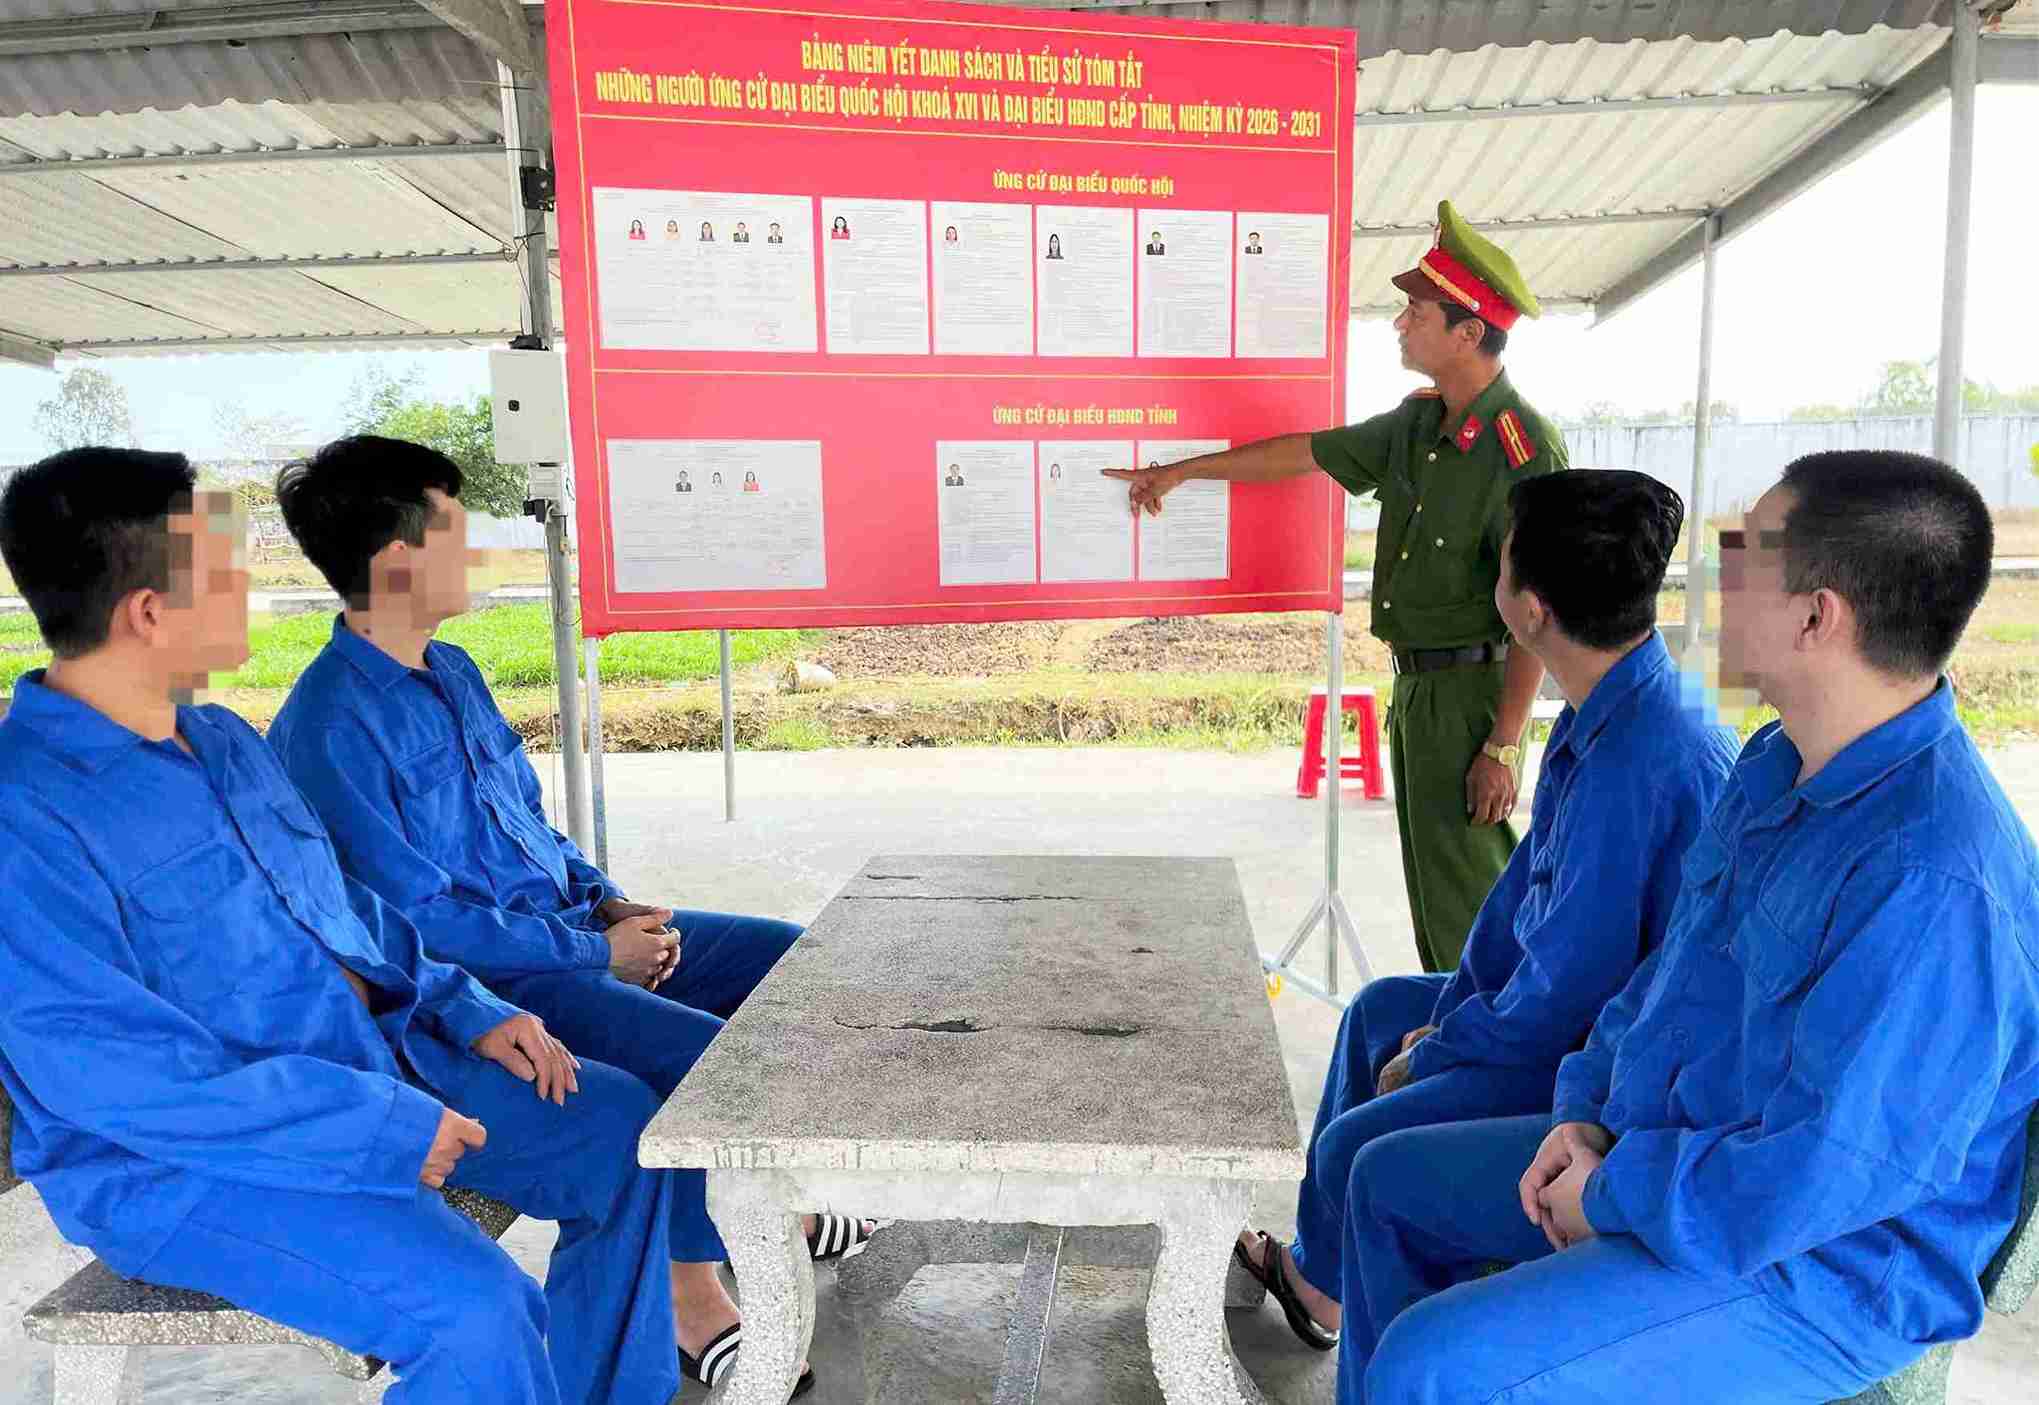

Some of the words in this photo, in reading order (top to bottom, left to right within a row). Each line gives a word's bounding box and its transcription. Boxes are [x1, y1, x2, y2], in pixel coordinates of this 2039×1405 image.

[801, 32, 844, 72] BẢNG
[847, 39, 886, 75] NIÊM
[890, 37, 916, 76] YẾT
[920, 48, 960, 77] DANH
[964, 44, 1002, 81] SÁCH
[1005, 48, 1024, 81] VÀ
[1028, 44, 1059, 83] TIỂU
[1063, 47, 1083, 85] SỬ
[1085, 53, 1115, 87] TÓM
[1119, 50, 1143, 88] TẮT
[595, 67, 652, 103] NHỮNG
[656, 69, 706, 106] NGƯỜI
[709, 72, 742, 109] ỨNG
[746, 71, 769, 110] CỬ
[770, 81, 797, 117] ĐẠI
[800, 74, 835, 113] BIỂU
[839, 78, 879, 117] QUỐC
[884, 83, 908, 123] HỘI
[912, 85, 952, 119] KHOÁ
[955, 91, 978, 121] XVI
[982, 89, 1000, 122] VÀ
[1004, 95, 1027, 128] ĐẠI
[1031, 86, 1063, 125] BIỂU
[1068, 98, 1105, 127] HĐND
[1109, 92, 1136, 128] CẤP
[1139, 93, 1175, 134] TỈNH,
[1179, 99, 1222, 138] NHIỆM
[1226, 101, 1244, 133] KỲ
[1247, 107, 1279, 135] 2026
[1291, 111, 1321, 137] 2031
[993, 169, 1024, 190] ỨNG
[1049, 174, 1073, 194] ĐẠI
[1076, 170, 1108, 193] BIỂU
[1111, 173, 1148, 195] QUỐC
[1151, 176, 1175, 198] HỘI
[1047, 408, 1070, 428] ĐẠI
[1073, 404, 1104, 425] BIỂU
